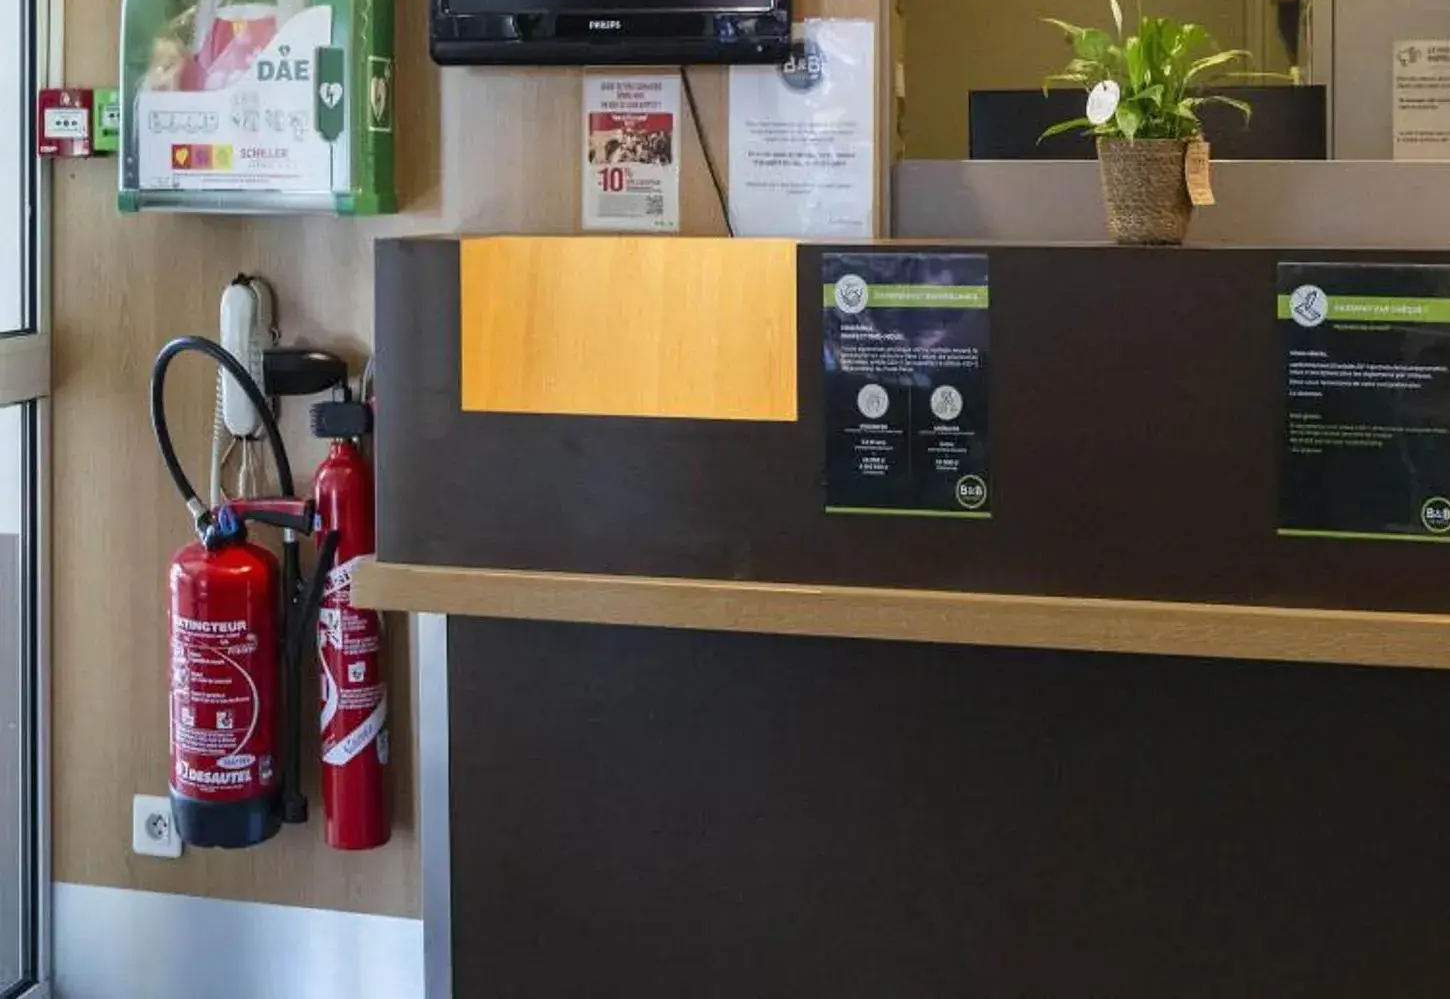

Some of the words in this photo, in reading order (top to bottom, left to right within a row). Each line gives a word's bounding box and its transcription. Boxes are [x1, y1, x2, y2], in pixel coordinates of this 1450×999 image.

[589, 20, 621, 30] PHILIPS
[257, 60, 310, 81] DAE
[1426, 508, 1450, 520] B&B
[189, 768, 252, 785] DESAUTEL
